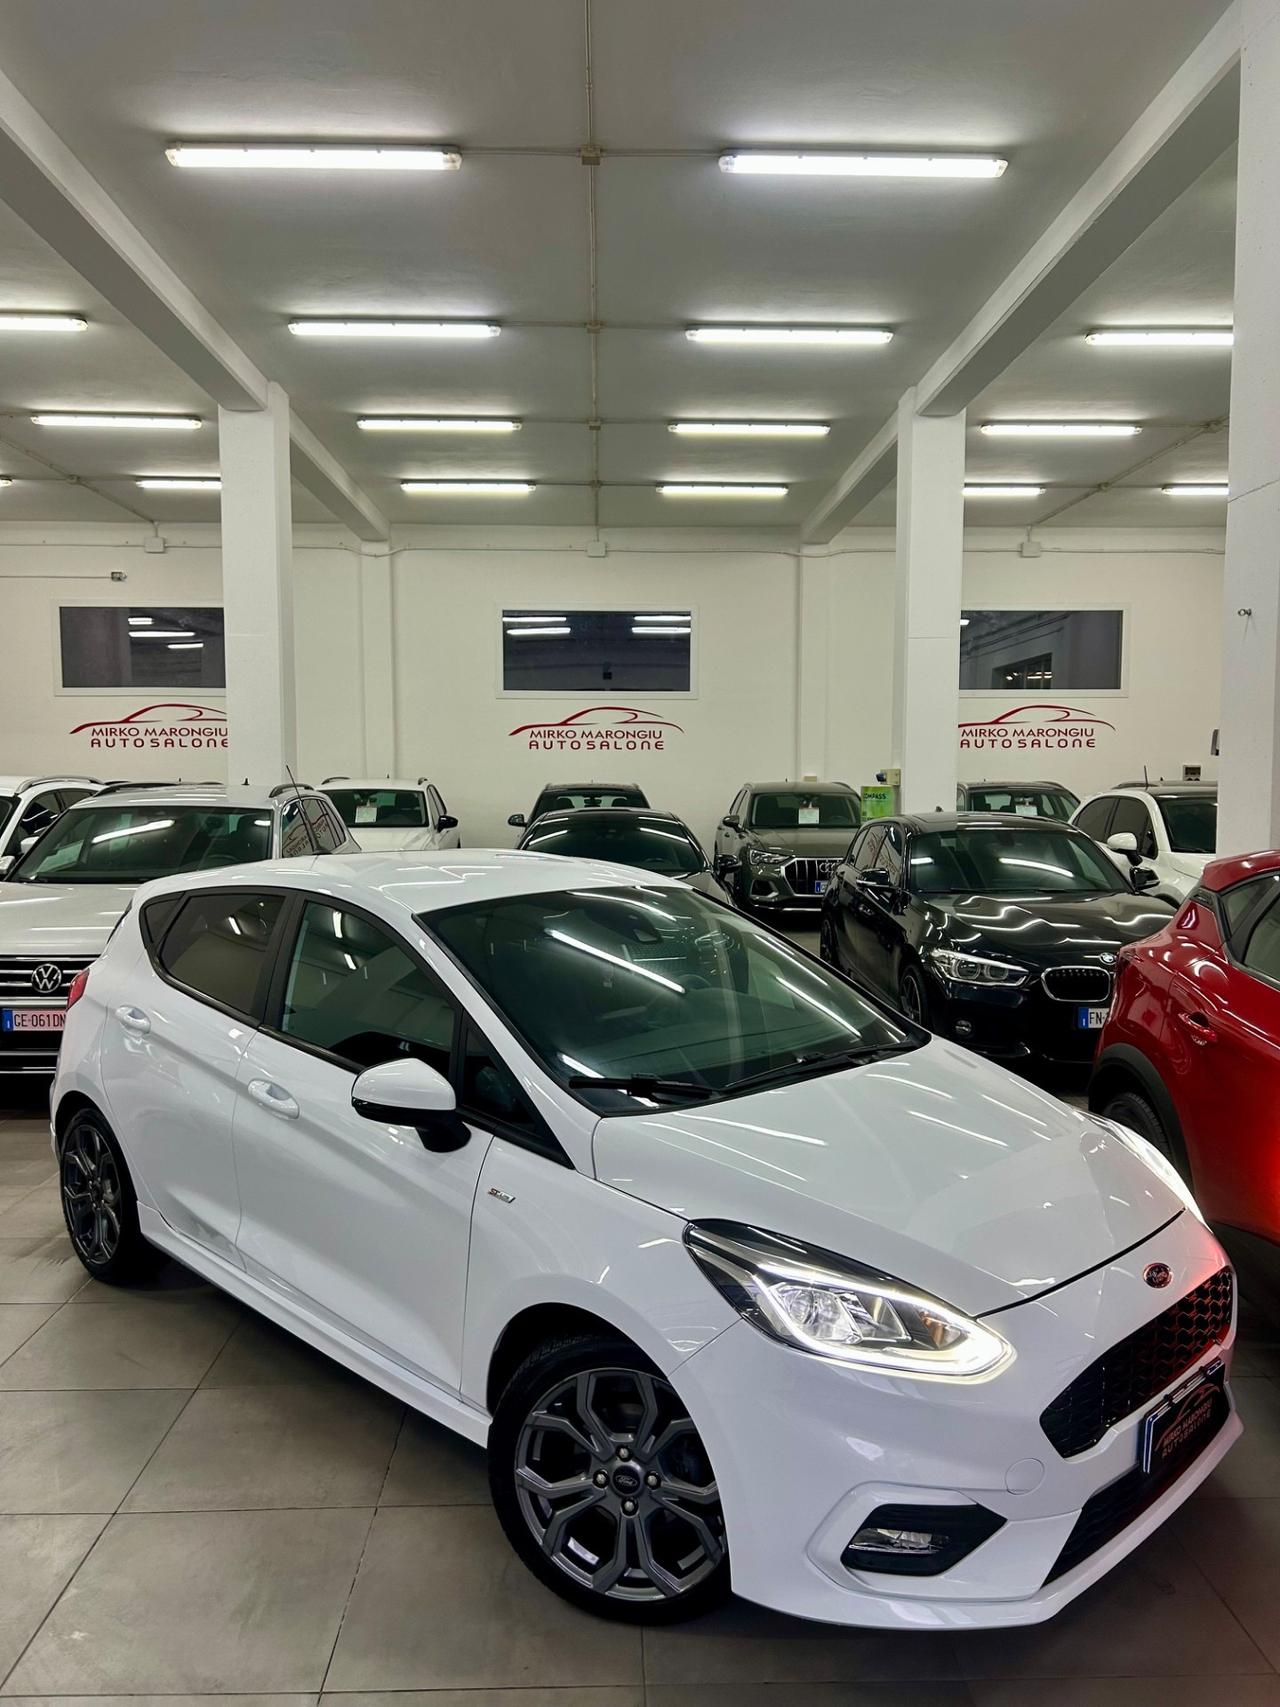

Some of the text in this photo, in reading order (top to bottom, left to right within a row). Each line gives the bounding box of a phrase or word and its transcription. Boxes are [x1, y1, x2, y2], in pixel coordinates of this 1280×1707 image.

[91, 727, 228, 737] MIRKO MARONGIU
[529, 729, 662, 739] MIRKO MARONGIU
[961, 728, 1094, 738] MIRKO MARONGIU
[90, 738, 229, 748] AUTOSALONE
[528, 740, 664, 750] AUTOSALONE
[959, 738, 1096, 749] AUTOSALONE
